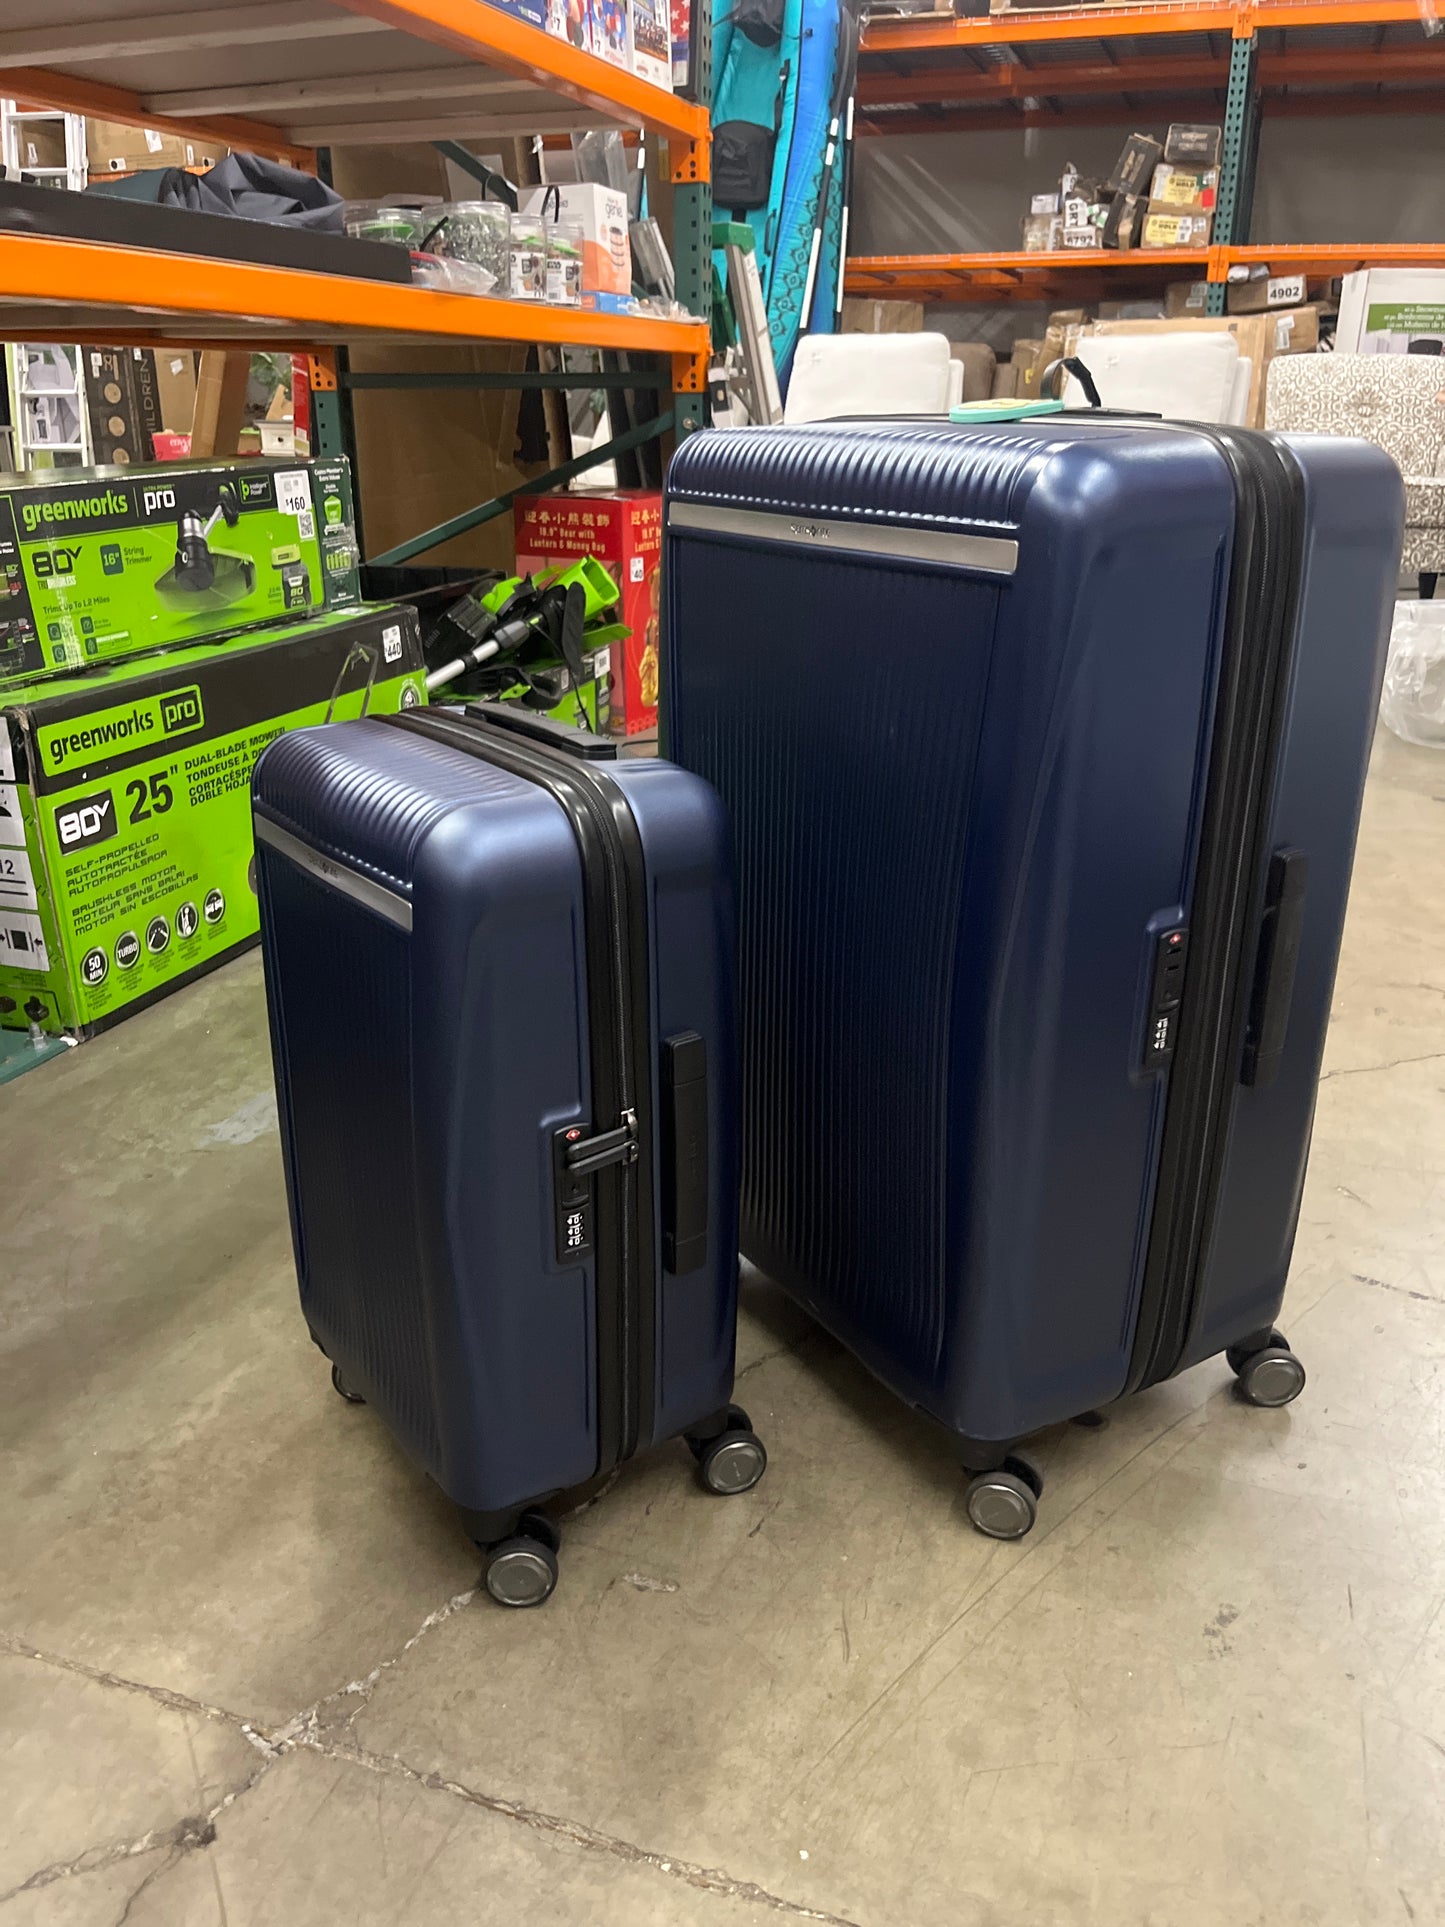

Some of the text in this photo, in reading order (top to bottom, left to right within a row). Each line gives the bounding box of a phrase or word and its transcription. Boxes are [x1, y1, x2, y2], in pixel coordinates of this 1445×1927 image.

[1269, 286, 1300, 300] 4902
[22, 489, 128, 532] greenworks
[143, 489, 176, 516] pro
[285, 497, 306, 512] $160
[578, 530, 596, 540] with
[124, 546, 145, 557] String
[566, 541, 590, 553] Money
[103, 553, 119, 566] 16"
[125, 555, 153, 566] Trimmer
[83, 598, 92, 607] 1.2
[93, 596, 110, 605] Miles
[50, 699, 197, 766] greenworks pro
[184, 739, 247, 771] DUAL-BLADE
[186, 755, 240, 784] TONDEUSE
[242, 751, 250, 765] À
[189, 787, 223, 807] DOBLE
[65, 833, 160, 878] SELF-PROPELLED
[67, 848, 148, 888] AUTOTRACTÉE
[68, 849, 168, 898] AUTOPROPULSADA
[72, 864, 177, 918] BRUSHLESS MOTOR
[73, 870, 185, 927] MOTEUR SANS BALAI
[75, 872, 199, 937] MOTOR SIN ESCOBILLAS
[117, 942, 138, 959] TURBO
[88, 955, 101, 972] 50
[89, 968, 103, 981] MIN
